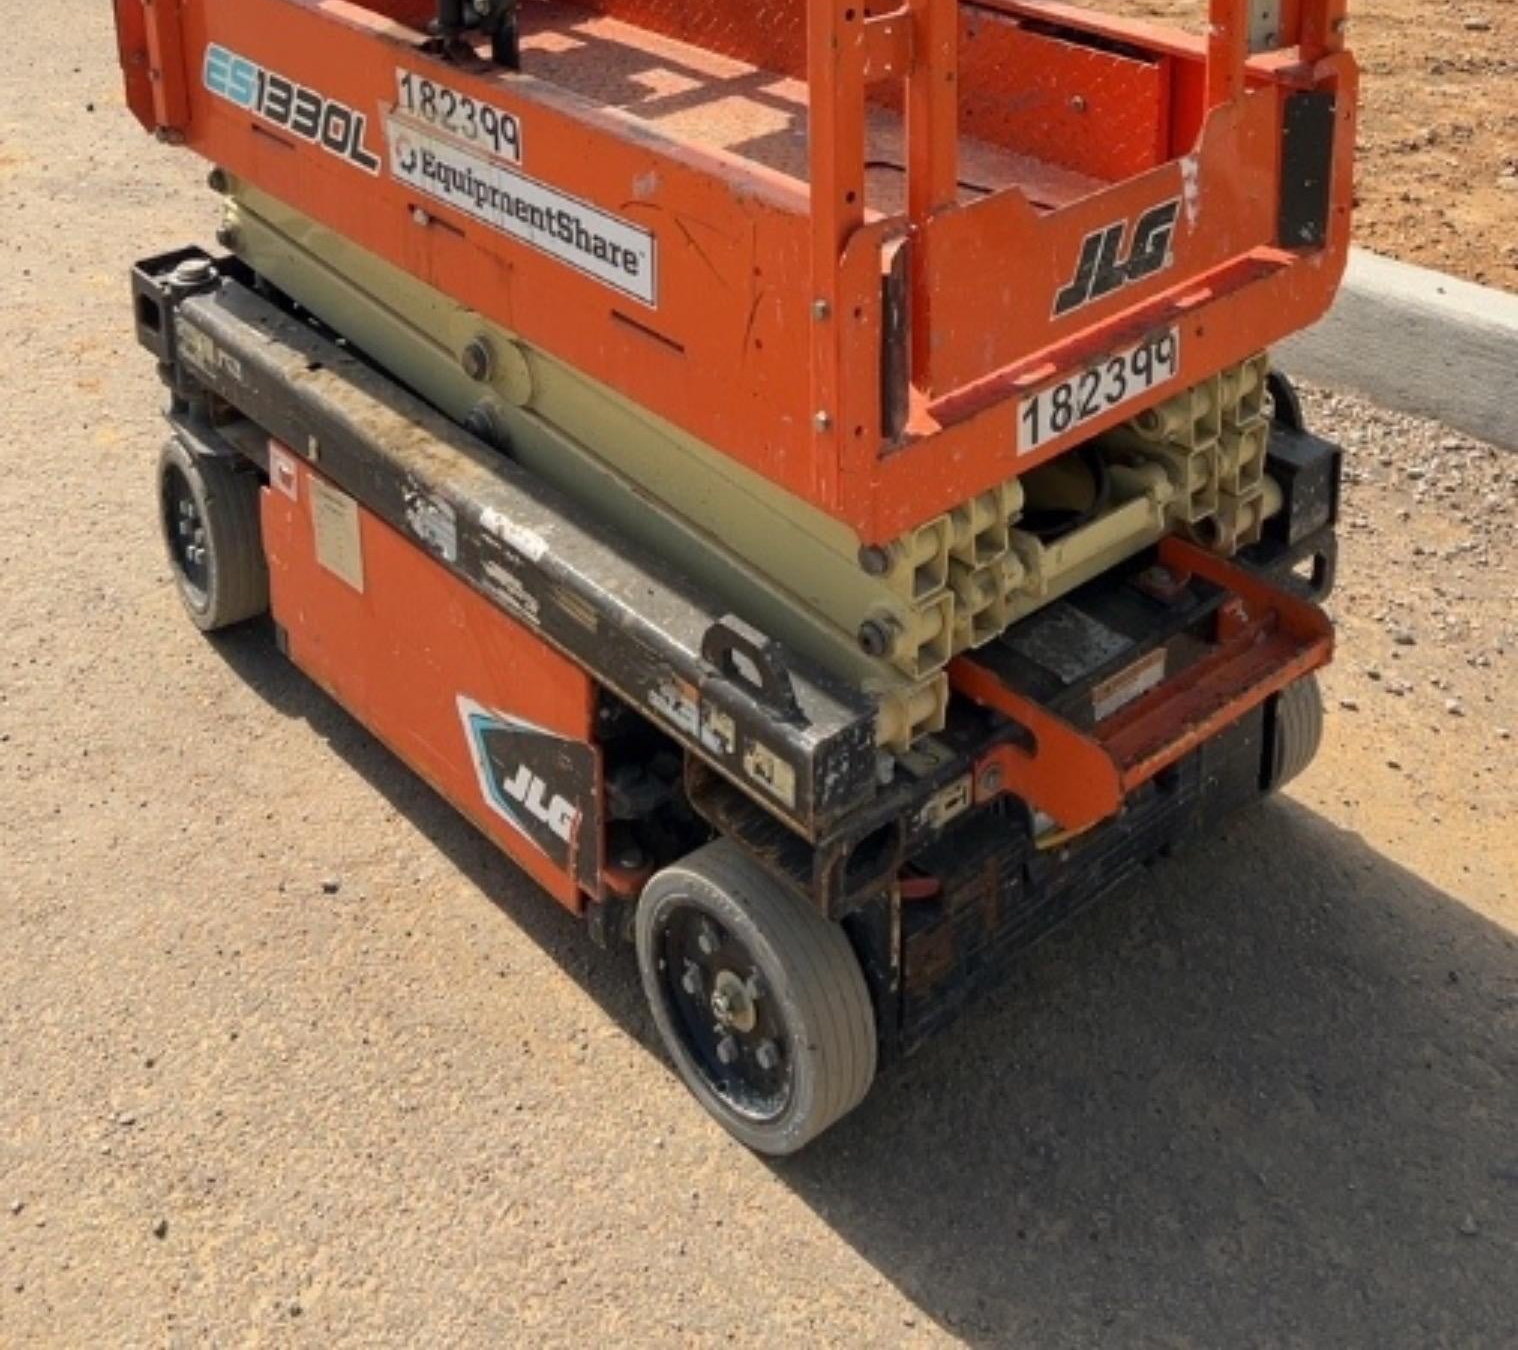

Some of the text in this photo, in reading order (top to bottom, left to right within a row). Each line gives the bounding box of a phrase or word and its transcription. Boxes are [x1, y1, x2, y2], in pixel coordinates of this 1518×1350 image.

[205, 44, 380, 174] ES1330L
[400, 71, 519, 162] 182399
[421, 152, 639, 277] EquipmentShare
[1052, 197, 1182, 319] JLG
[1022, 333, 1175, 445] 182399
[503, 763, 582, 844] JLG
